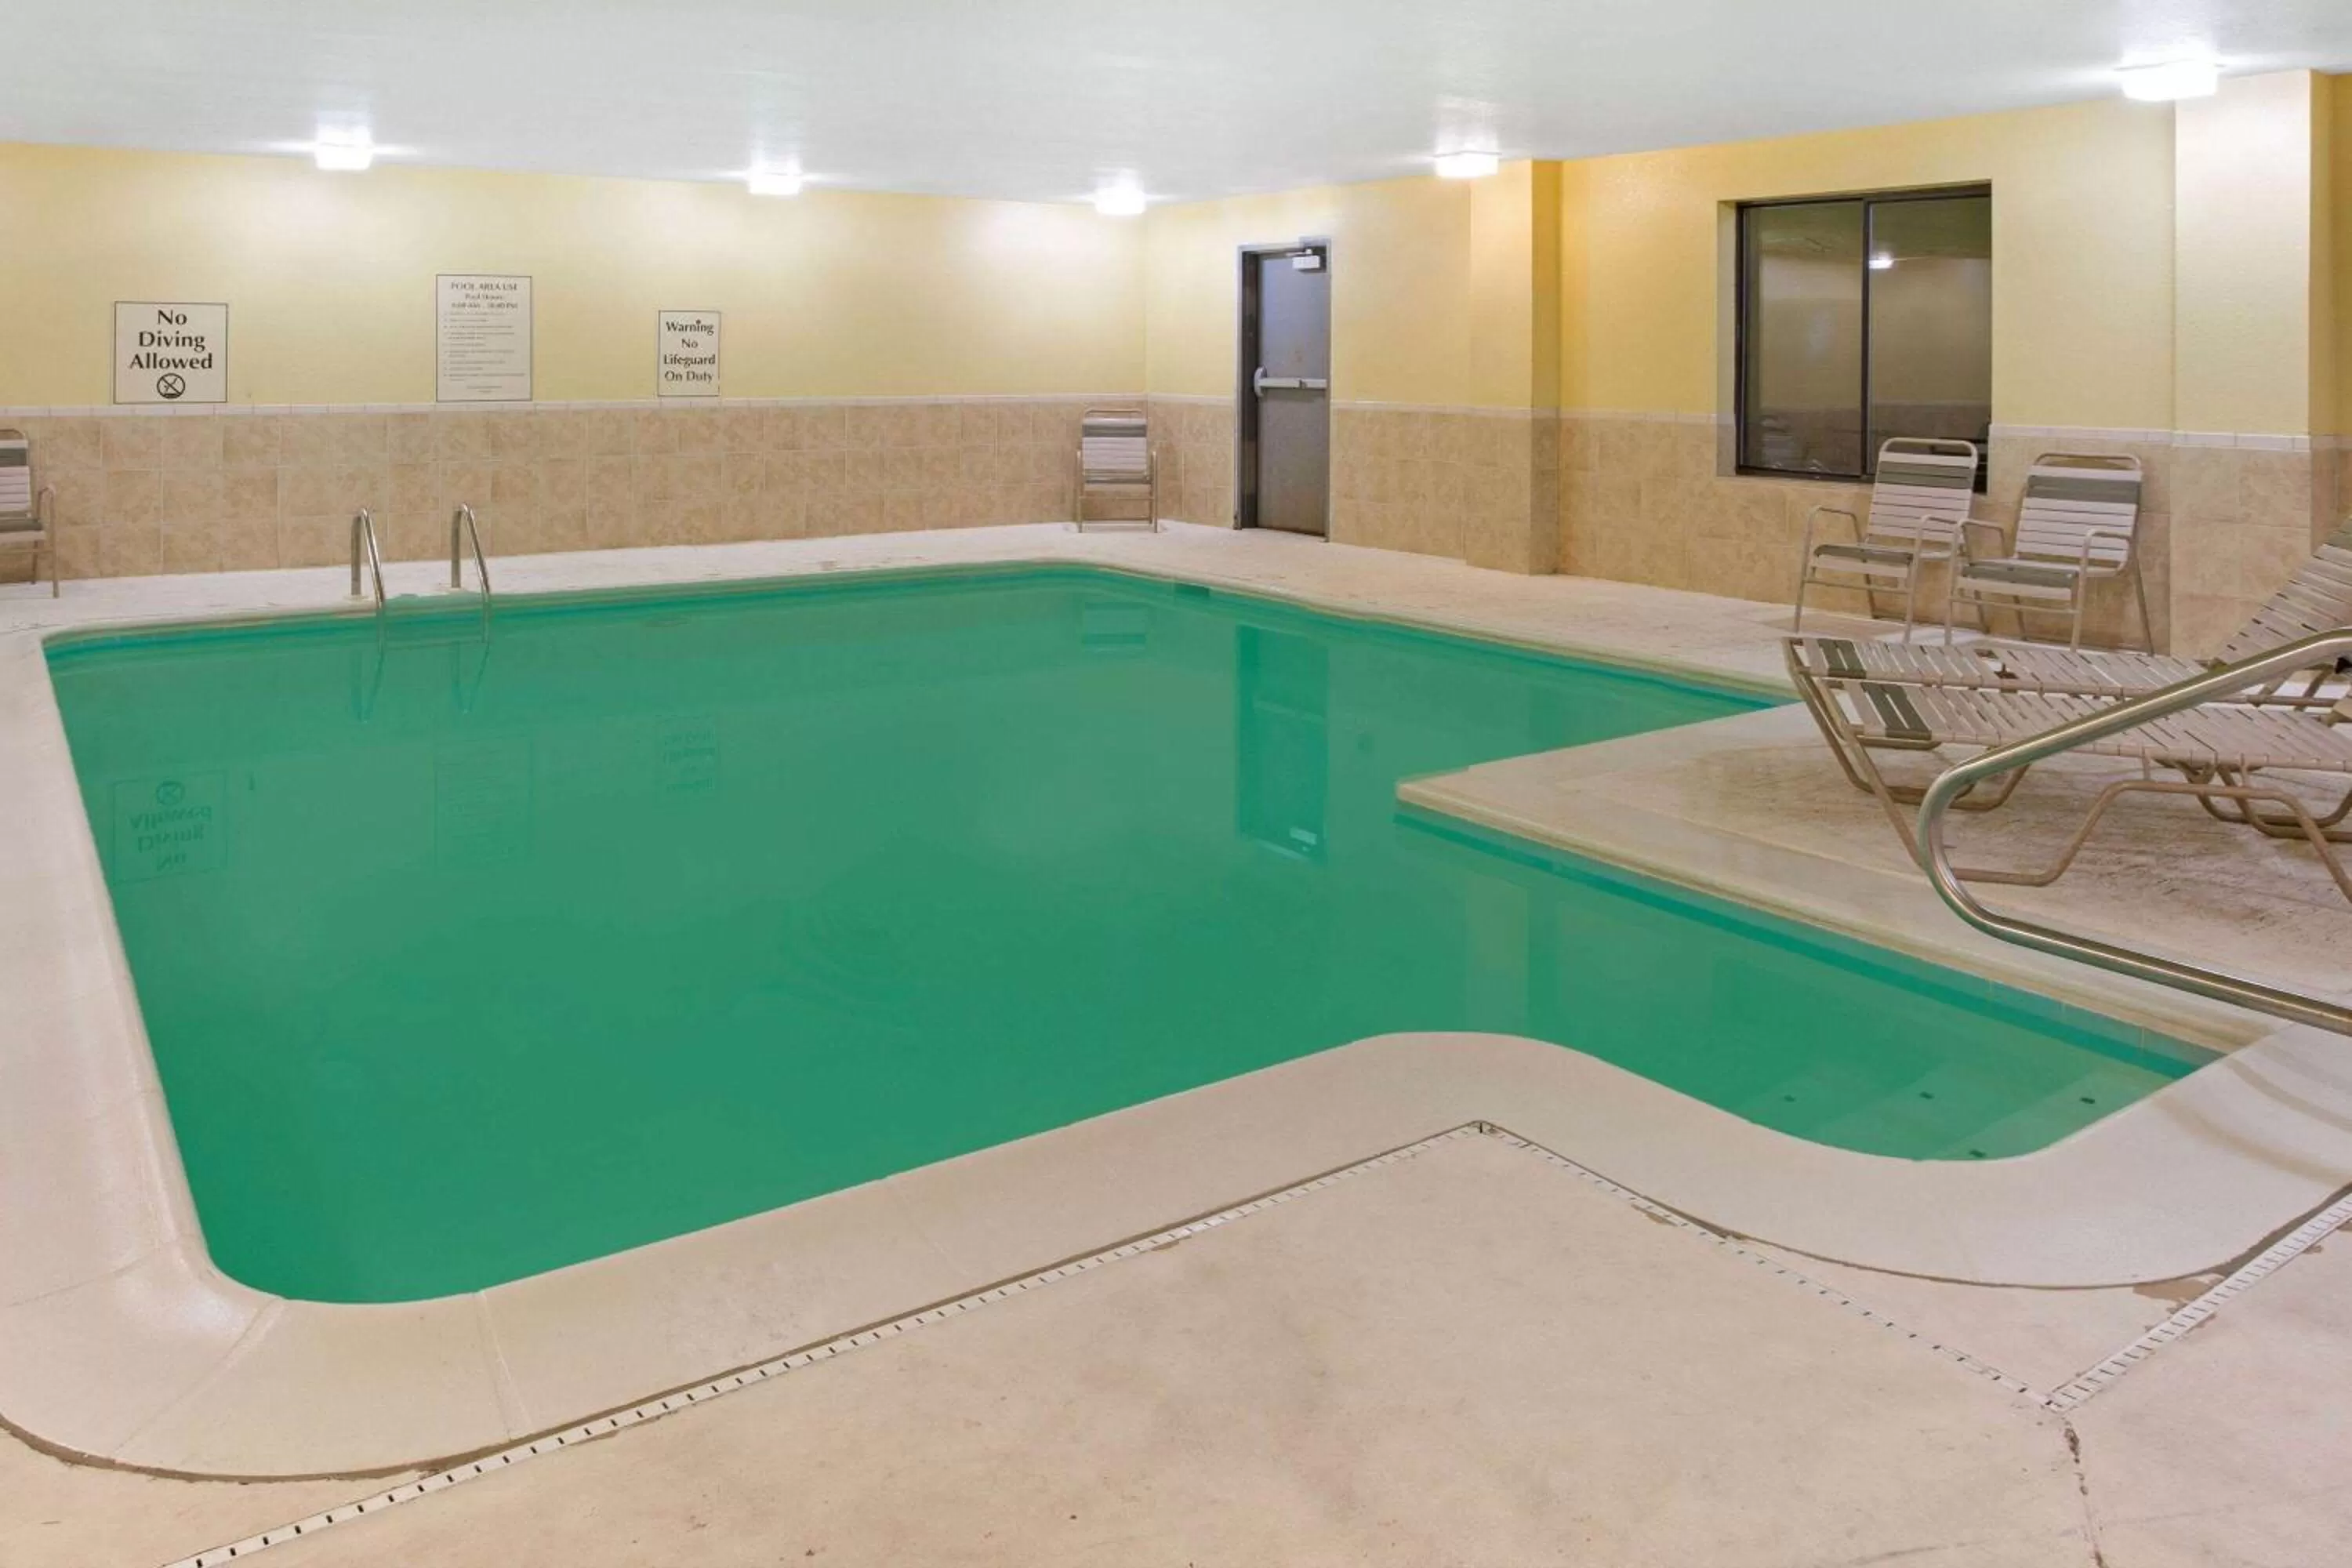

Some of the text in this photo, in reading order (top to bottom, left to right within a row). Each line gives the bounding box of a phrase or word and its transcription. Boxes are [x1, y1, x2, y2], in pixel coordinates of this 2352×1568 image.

[451, 281, 475, 291] POOL
[479, 282, 503, 291] AREA
[158, 310, 187, 325] No
[666, 319, 714, 336] Warning
[138, 330, 205, 353] Diving
[681, 339, 699, 348] No
[129, 352, 212, 369] Allowed
[663, 354, 716, 368] Lifeguard
[665, 370, 713, 383] On Duty
